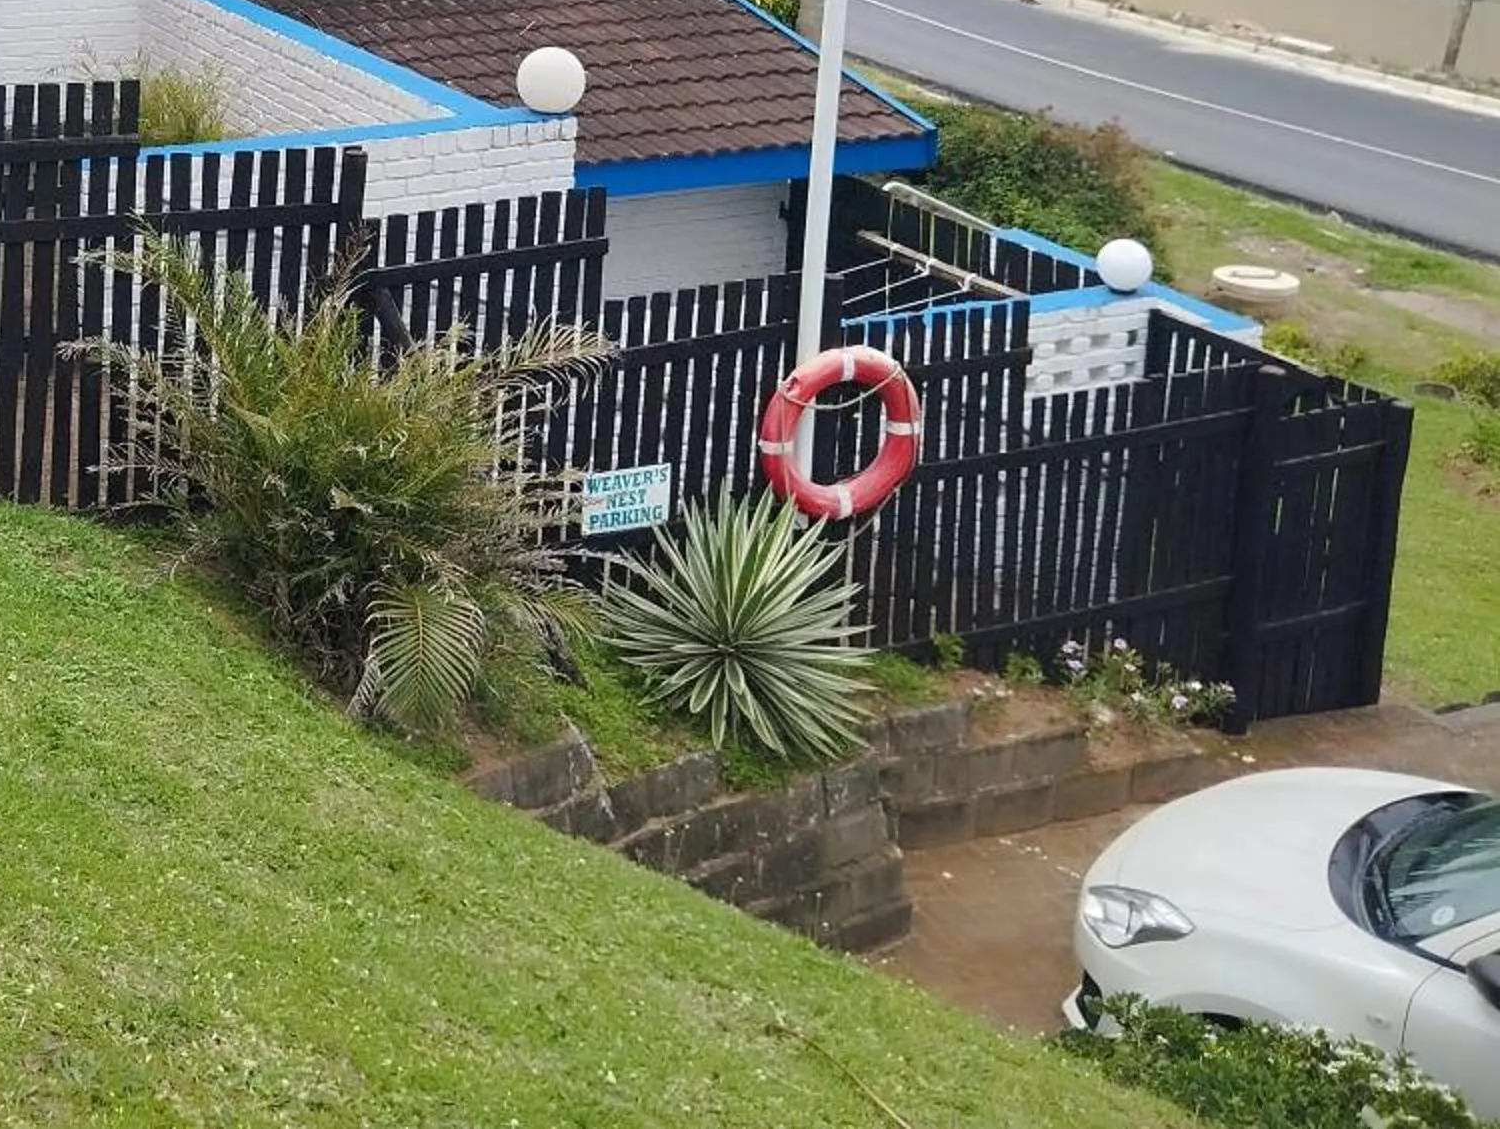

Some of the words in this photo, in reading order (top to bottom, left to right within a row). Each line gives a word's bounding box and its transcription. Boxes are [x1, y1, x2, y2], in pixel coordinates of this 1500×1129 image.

[586, 467, 668, 493] WEAVER'S
[607, 488, 646, 510] NEST
[589, 505, 663, 530] PARKING
